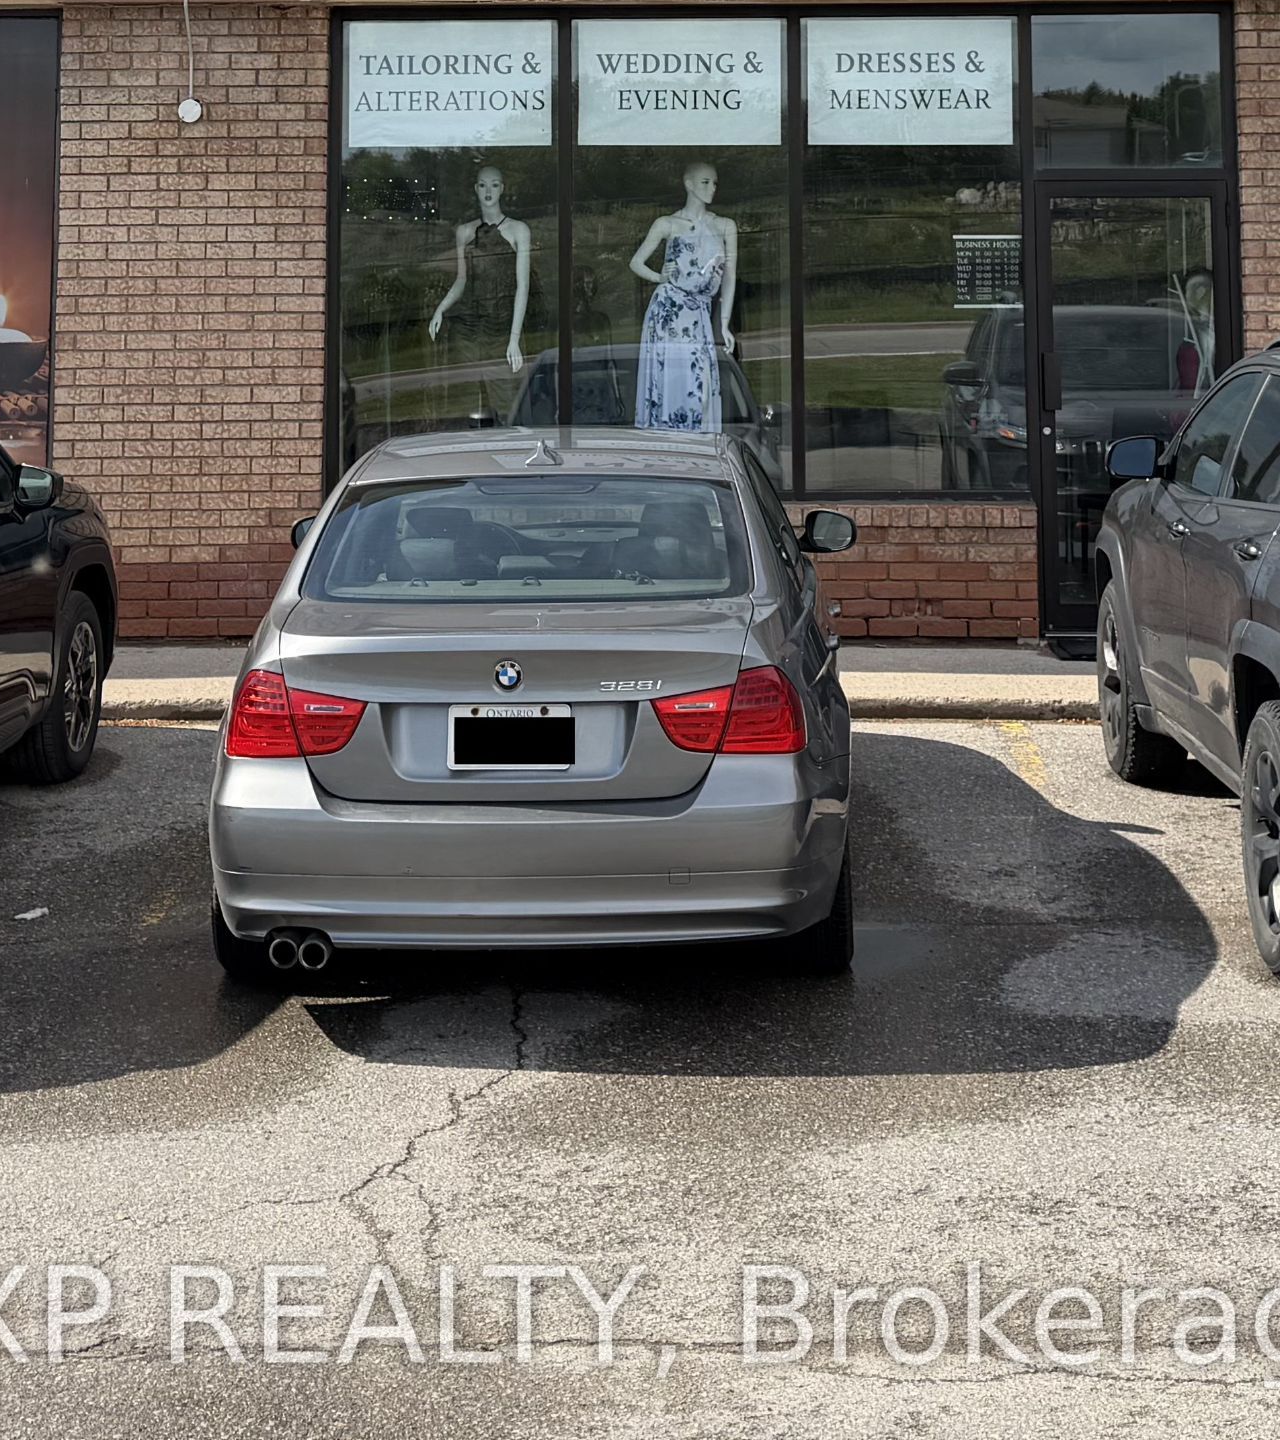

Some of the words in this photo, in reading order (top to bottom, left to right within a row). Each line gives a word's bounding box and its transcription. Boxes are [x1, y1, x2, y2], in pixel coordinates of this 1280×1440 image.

[358, 53, 514, 76] TAILORING
[519, 52, 543, 76] &
[595, 52, 736, 76] WEDDING
[742, 51, 765, 75] &
[834, 51, 957, 75] DRESSES
[963, 50, 987, 75] &
[353, 88, 547, 113] ALTERATIONS
[616, 88, 743, 111] EVENING
[827, 87, 993, 111] MENSWEAR
[486, 708, 534, 718] ONTARIO
